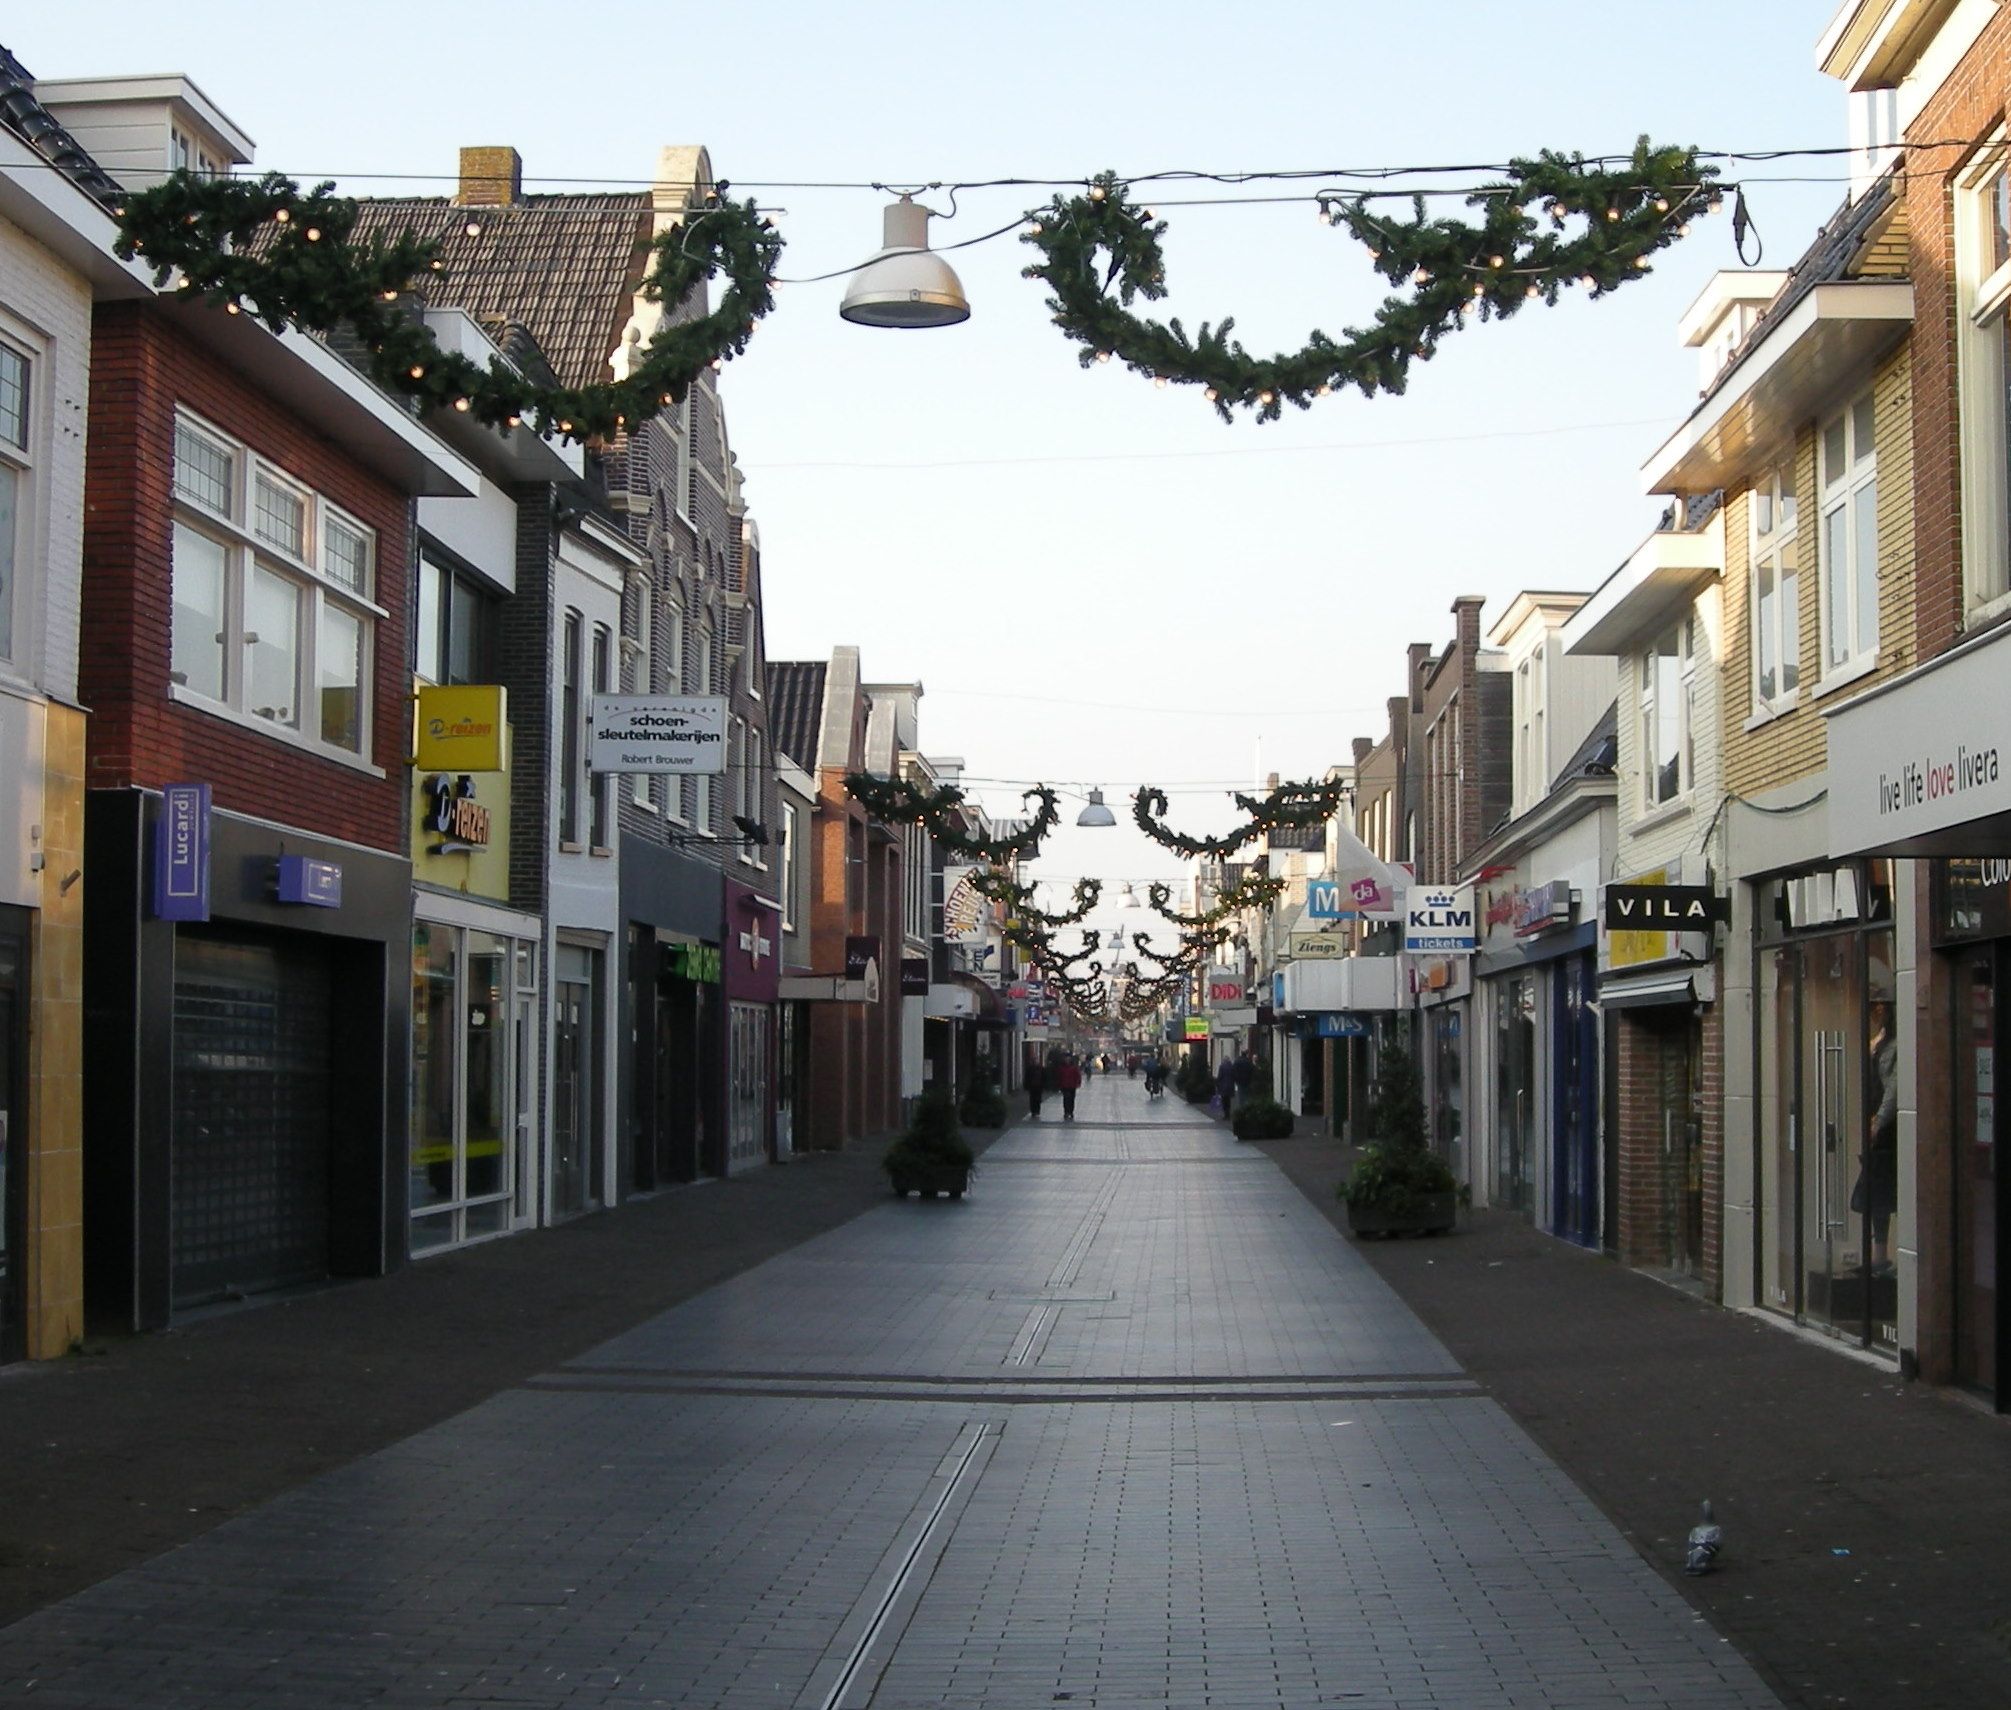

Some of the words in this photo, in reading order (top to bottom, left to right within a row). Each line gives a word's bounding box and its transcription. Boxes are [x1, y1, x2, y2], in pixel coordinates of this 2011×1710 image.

[630, 714, 689, 726] schoen-
[598, 728, 720, 744] sleutelmakerijen
[622, 754, 653, 764] Robert
[655, 754, 695, 765] Brouwer
[1880, 774, 1900, 815] live
[1904, 762, 1923, 808] life
[1927, 758, 1954, 800] love
[1958, 746, 1998, 791] livera
[174, 793, 188, 865] Lucardi
[1354, 884, 1373, 900] da
[1786, 867, 1859, 928] VILA
[1618, 899, 1705, 917] VILA
[1410, 911, 1471, 927] KLM
[1297, 943, 1336, 954] Ziengs
[1419, 939, 1464, 949] tickets
